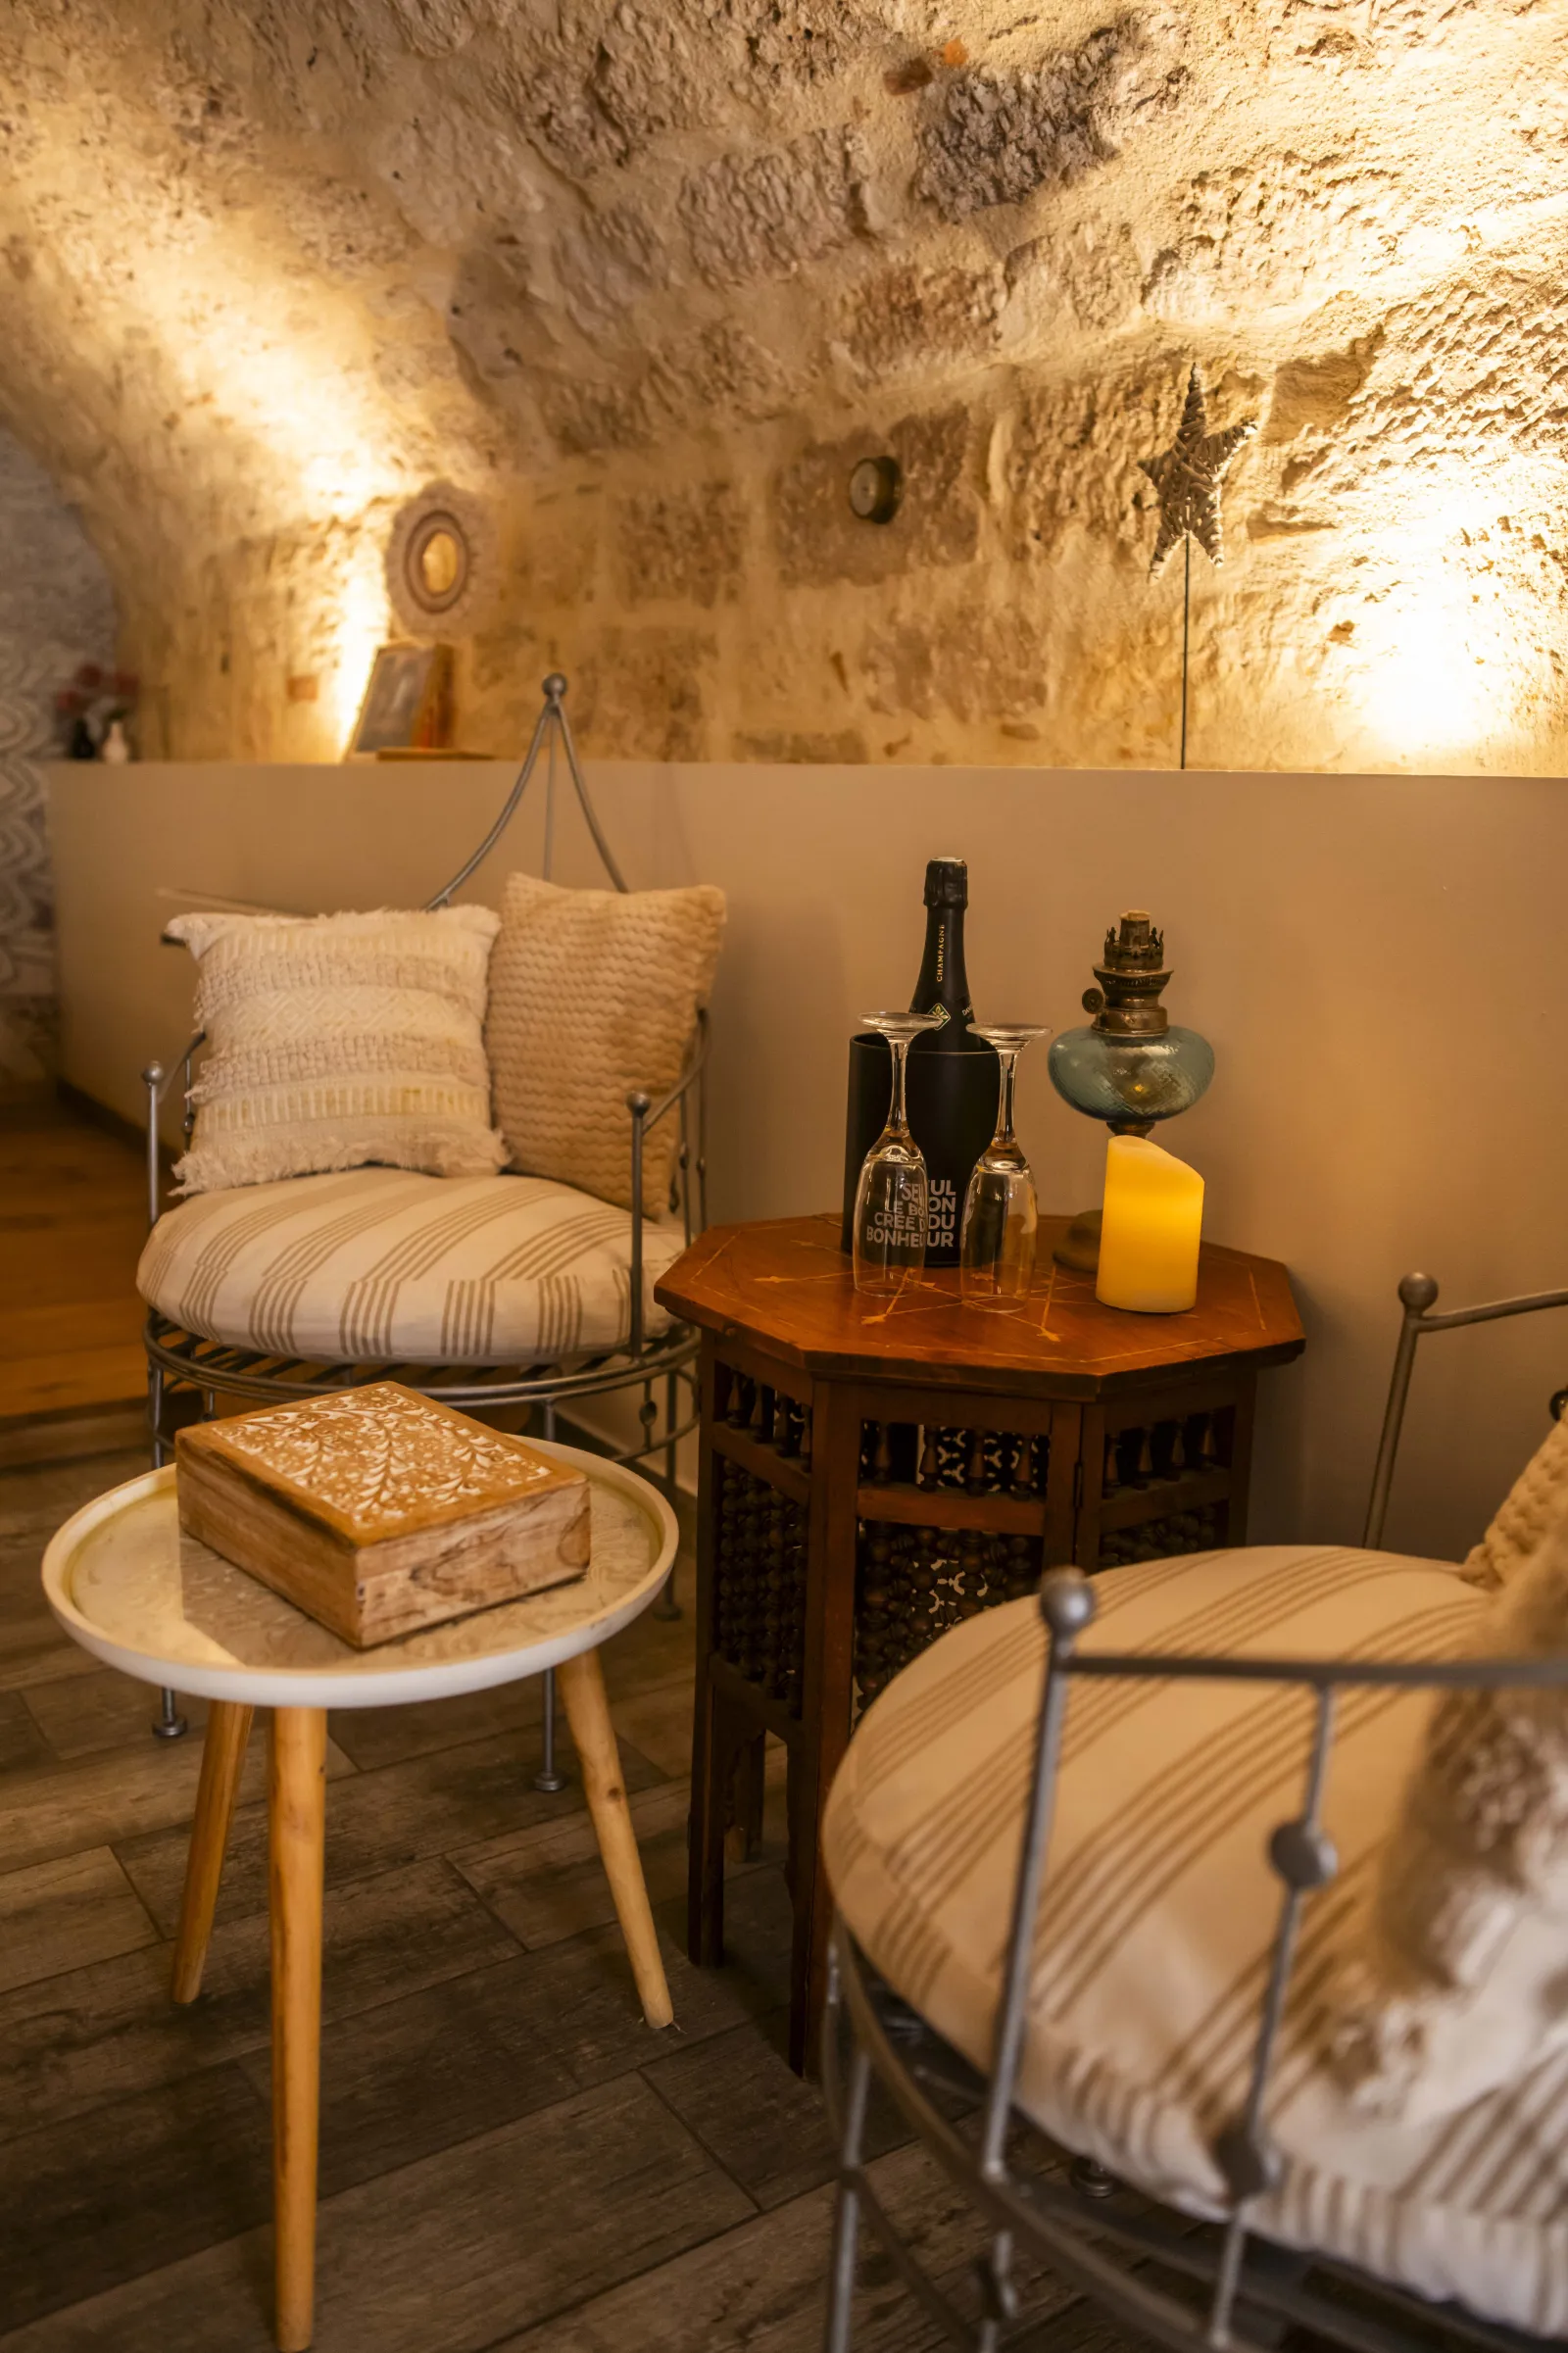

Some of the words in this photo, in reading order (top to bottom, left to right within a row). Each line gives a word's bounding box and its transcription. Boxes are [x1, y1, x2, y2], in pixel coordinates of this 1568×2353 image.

[936, 923, 946, 983] CHAMPAGNE
[885, 1201, 904, 1215] LE
[874, 1211, 916, 1231] CREE
[866, 1225, 955, 1248] BONHEUR
